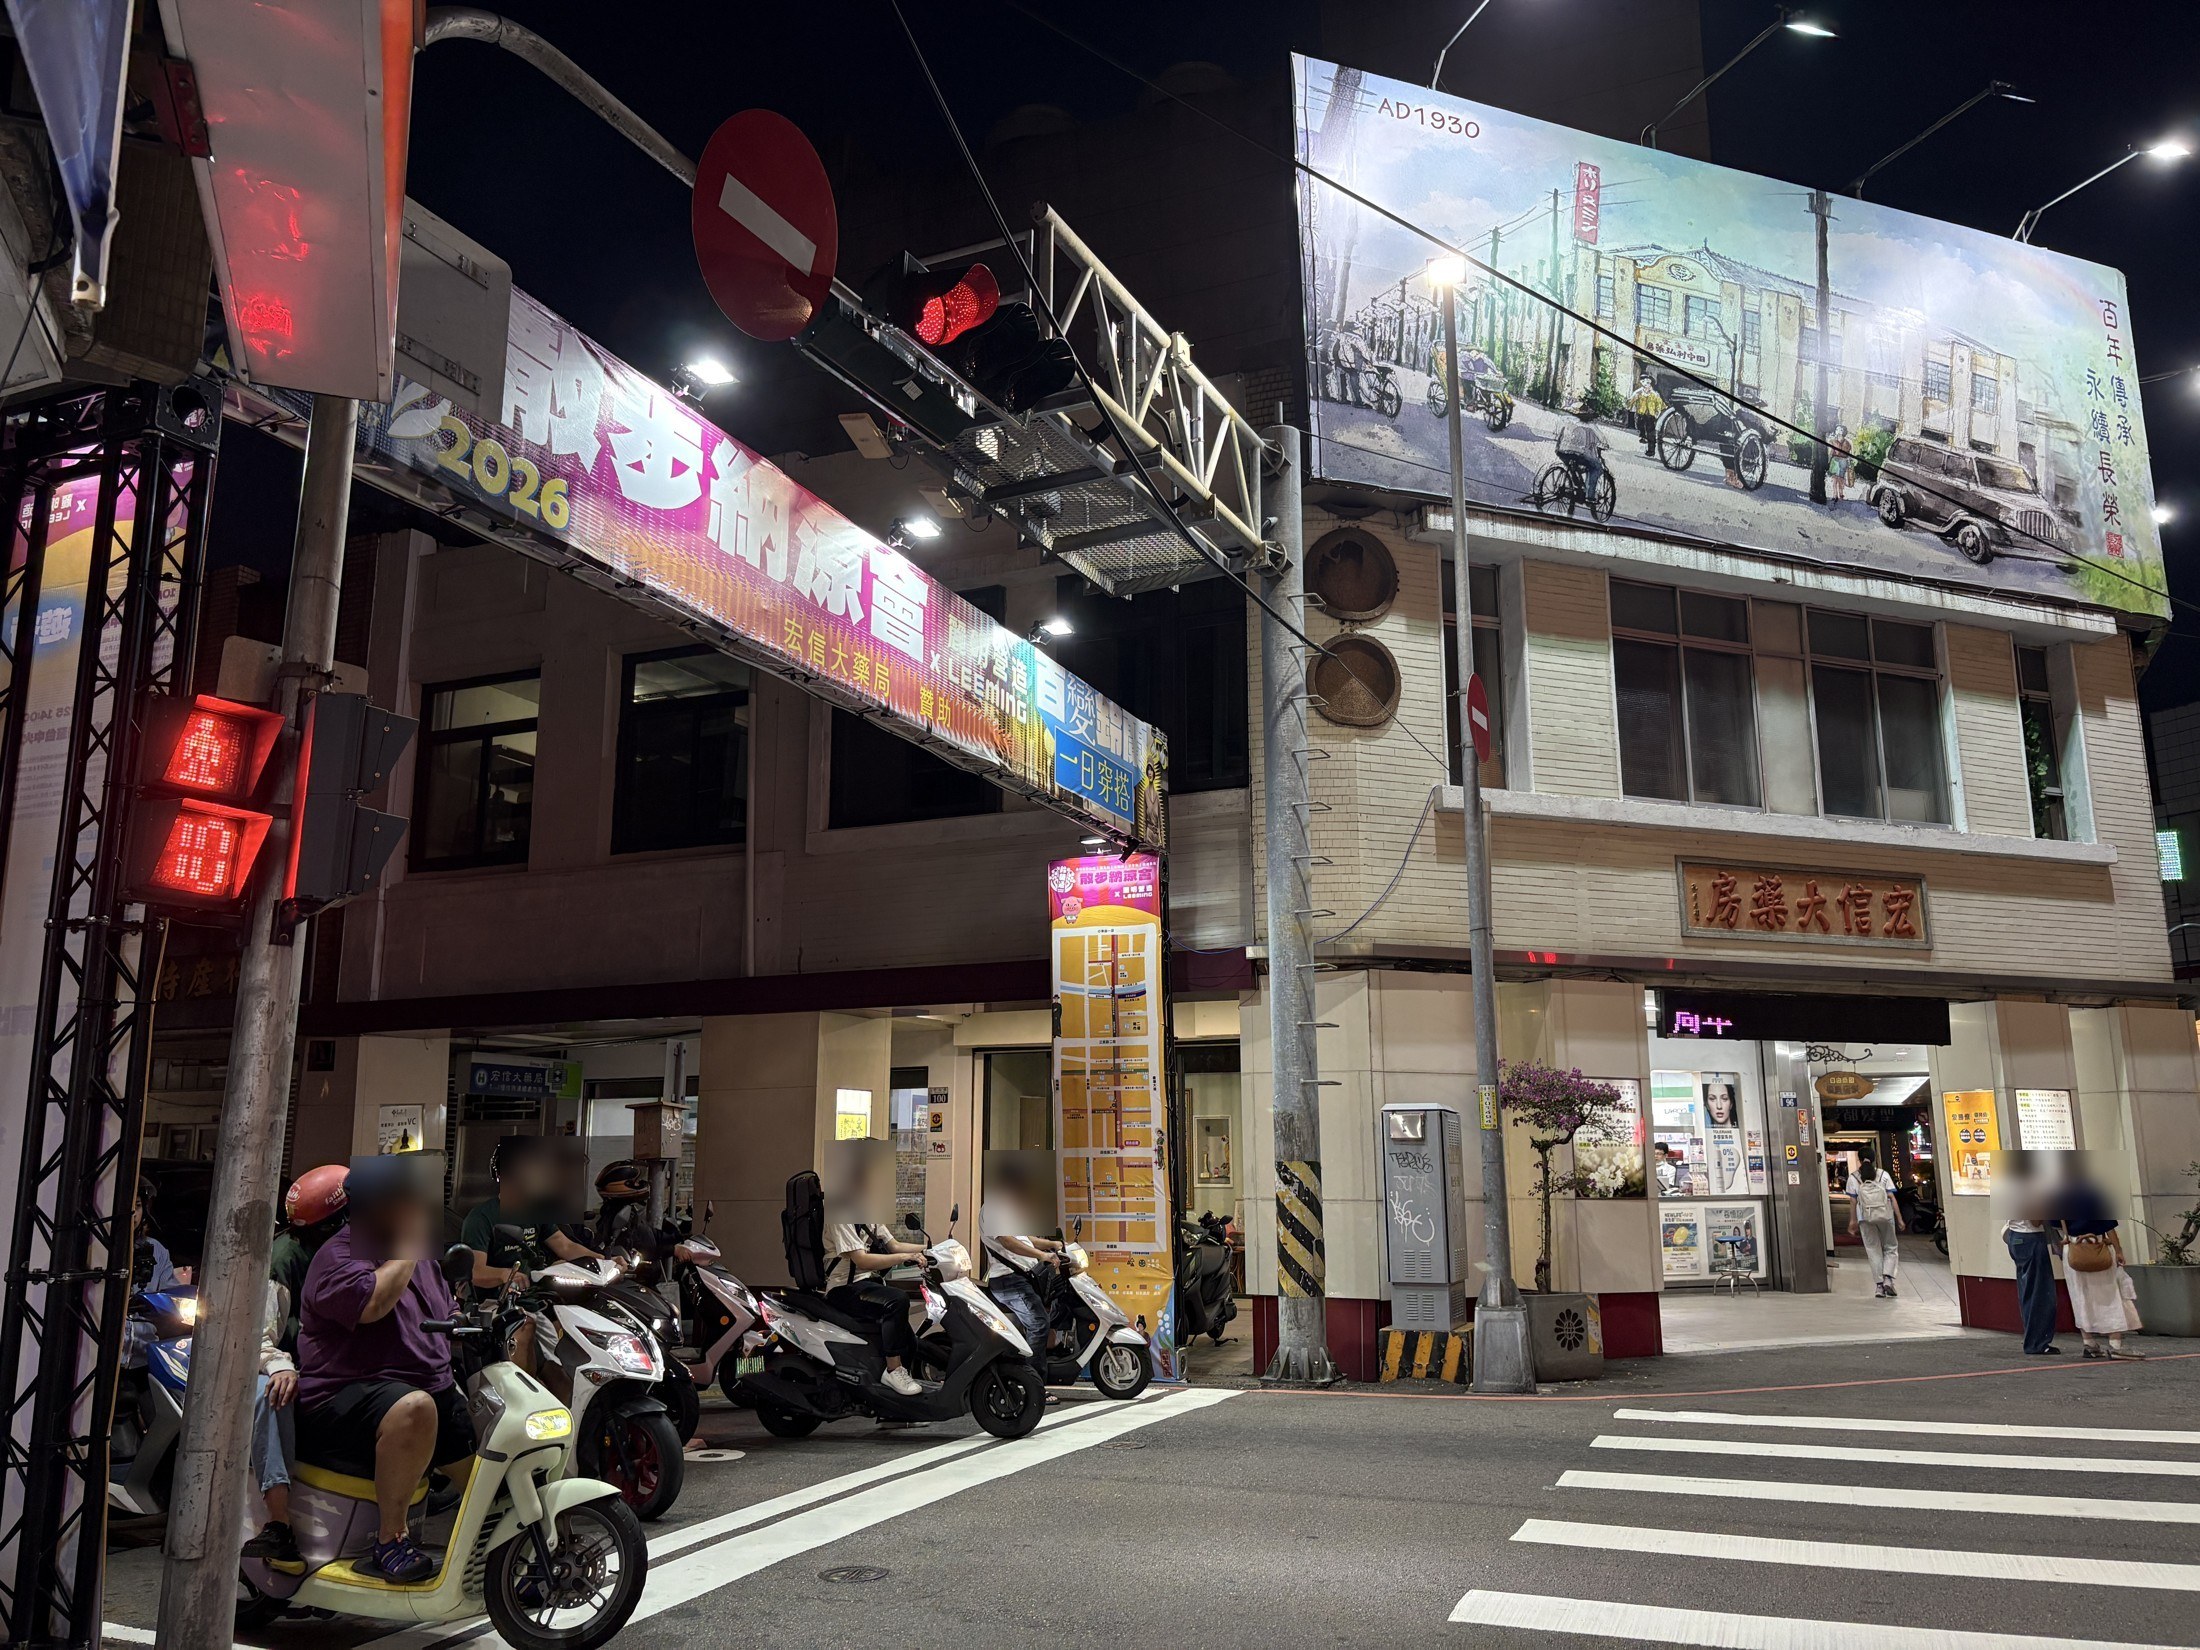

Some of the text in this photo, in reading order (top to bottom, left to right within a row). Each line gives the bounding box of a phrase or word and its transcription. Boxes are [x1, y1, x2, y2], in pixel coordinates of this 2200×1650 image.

[1377, 97, 1481, 139] AD1930
[2099, 298, 2135, 447] 百年傳承
[437, 416, 571, 530] 2026
[2086, 368, 2122, 526] 永續長榮
[783, 618, 951, 729] 宏信大藥局 贊助
[1059, 749, 1131, 812] 一日穿搭
[1705, 870, 1917, 937] 宏信大藥房
[490, 1070, 543, 1084] 宏信大藥局
[932, 1094, 946, 1103] 100
